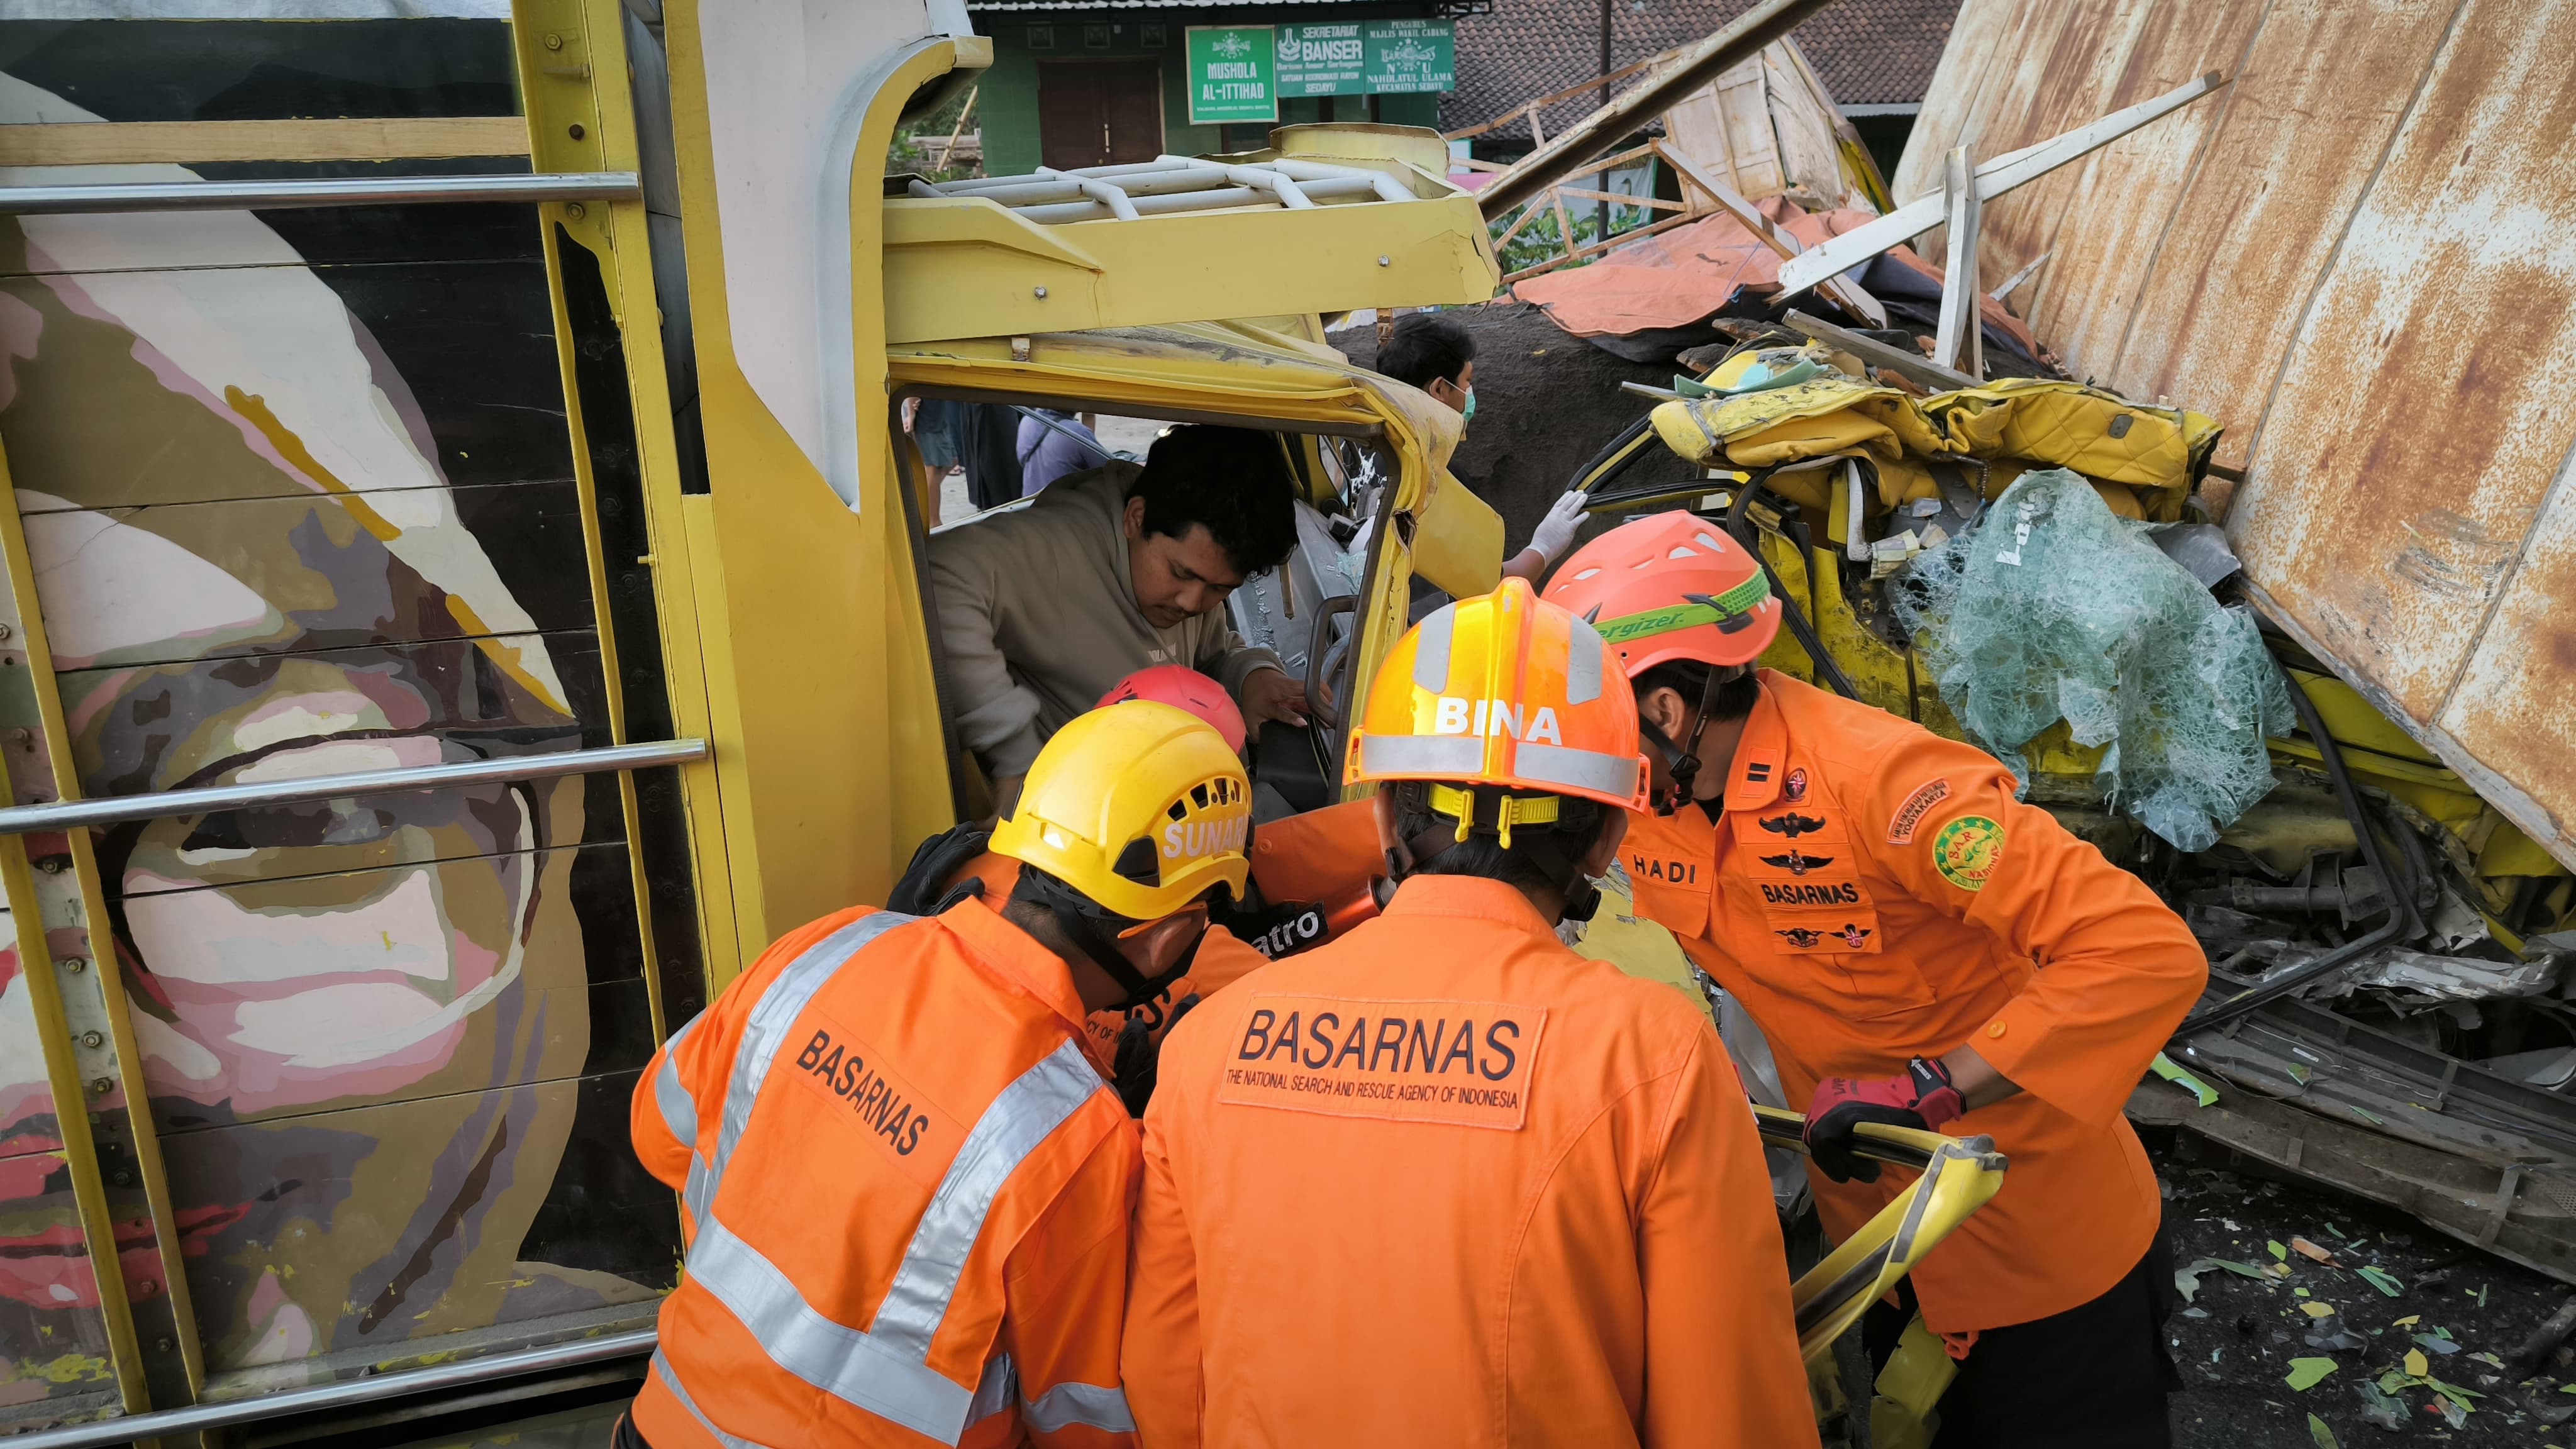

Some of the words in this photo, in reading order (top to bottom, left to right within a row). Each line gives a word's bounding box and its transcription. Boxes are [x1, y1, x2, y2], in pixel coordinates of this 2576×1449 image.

[1302, 25, 1359, 38] SEKRETARIAT
[1302, 40, 1363, 62] BANSER
[1207, 62, 1257, 80] MUSHOLA
[1367, 73, 1419, 84] NAHDLATUL
[1421, 72, 1452, 82] ULAMA
[1387, 64, 1396, 74] N
[1423, 62, 1431, 74] U
[1202, 82, 1264, 101] AL-ITTIHAD
[1305, 82, 1336, 93] SEDAYU
[1376, 82, 1416, 92] KECAMATAN
[1434, 696, 1563, 747] BINA
[1901, 791, 1947, 836] YOGYAKARTA
[1948, 831, 1976, 859] SAR
[1633, 853, 1696, 884] HADI
[1761, 882, 1859, 906] BASARNAS
[1100, 1026, 1114, 1039] OF
[1238, 1009, 1520, 1081] BASARNAS
[796, 1028, 930, 1157] BASARNAS
[1226, 1069, 1243, 1084] THE
[1243, 1070, 1288, 1090] NATIONAL
[1291, 1075, 1333, 1095] SEARCH
[1333, 1081, 1353, 1097] AND
[1356, 1082, 1396, 1100] RESCUE
[1397, 1085, 1438, 1102] AGENCY
[1440, 1088, 1457, 1105] OF
[1458, 1089, 1518, 1109] INDONESIA
